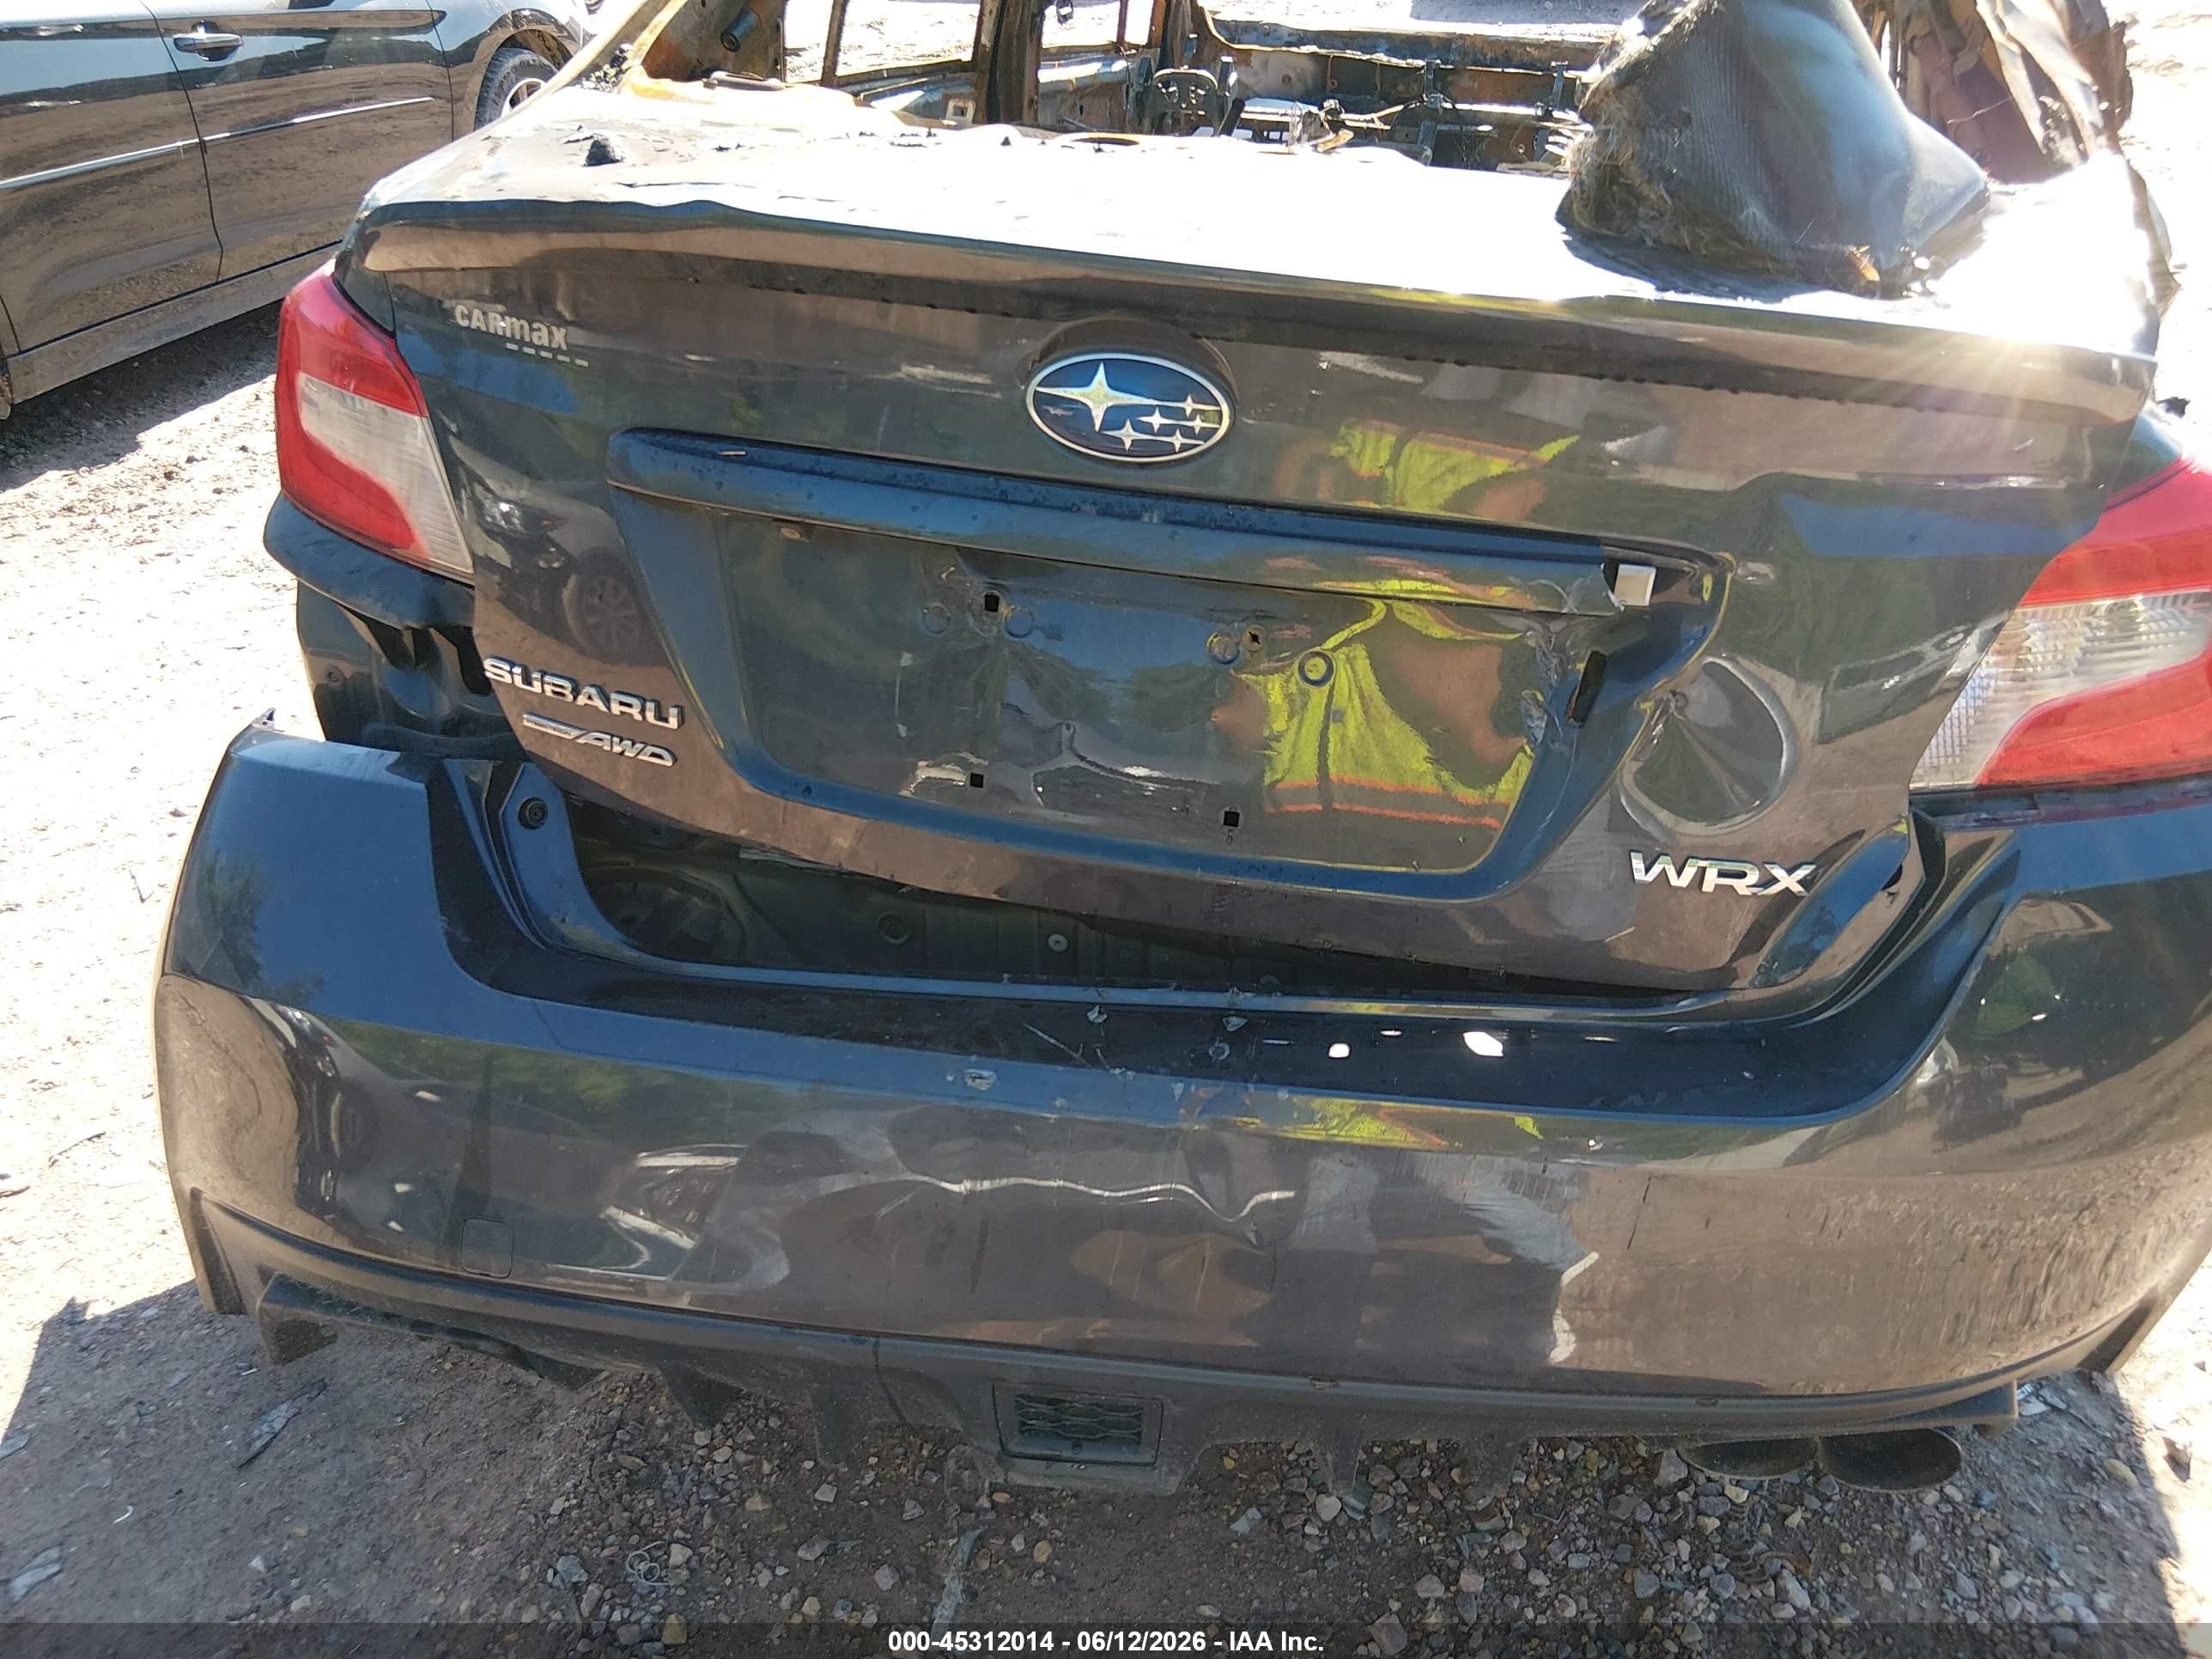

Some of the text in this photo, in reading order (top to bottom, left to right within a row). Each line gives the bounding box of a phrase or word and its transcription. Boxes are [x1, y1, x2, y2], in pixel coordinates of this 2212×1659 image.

[483, 656, 684, 730] SUBARU
[576, 731, 676, 767] AWD
[1630, 850, 1818, 897] WRX
